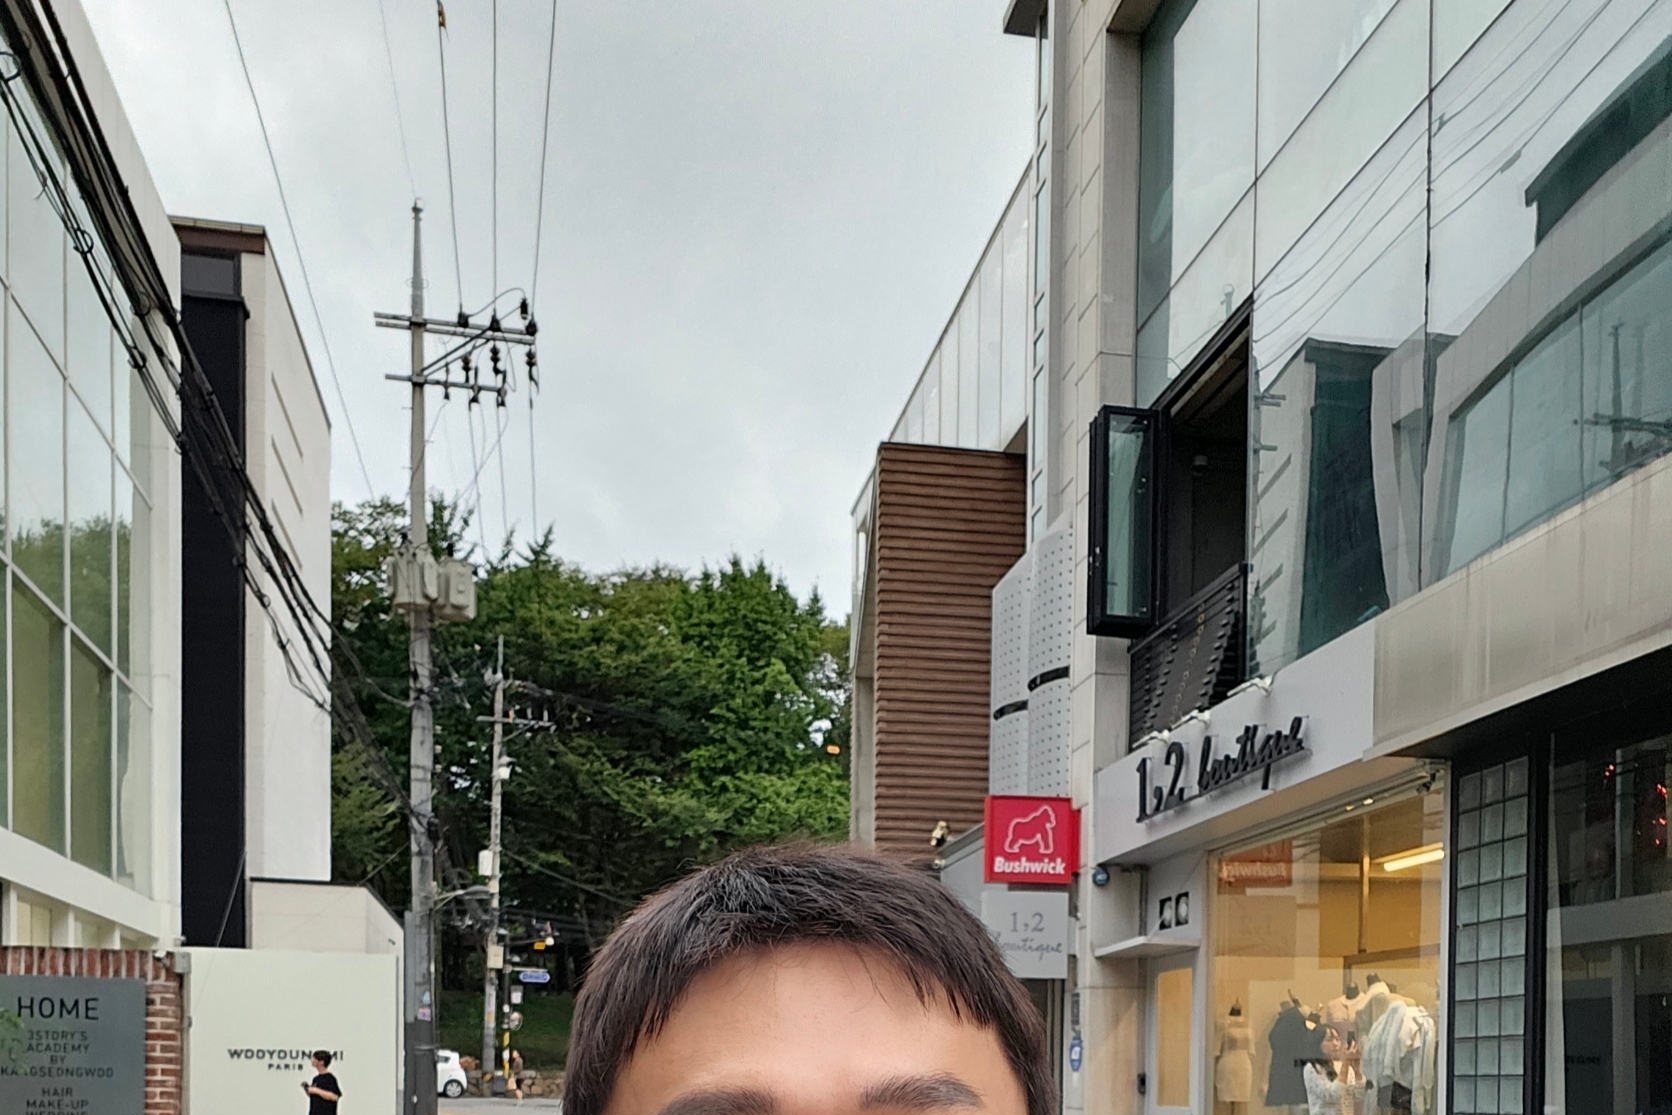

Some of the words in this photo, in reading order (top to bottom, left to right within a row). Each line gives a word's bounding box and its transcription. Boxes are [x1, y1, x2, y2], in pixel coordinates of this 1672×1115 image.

[1198, 716, 1305, 795] boutique
[993, 856, 1066, 875] Bushwick
[1010, 911, 1045, 933] 1,2
[17, 996, 99, 1020] HOME
[26, 1042, 90, 1053] ACADEMY
[49, 1055, 66, 1065] BY
[1, 1065, 114, 1078] KAGSEONGWOO
[41, 1087, 73, 1097] HAIR
[26, 1099, 89, 1110] MAKE-UP
